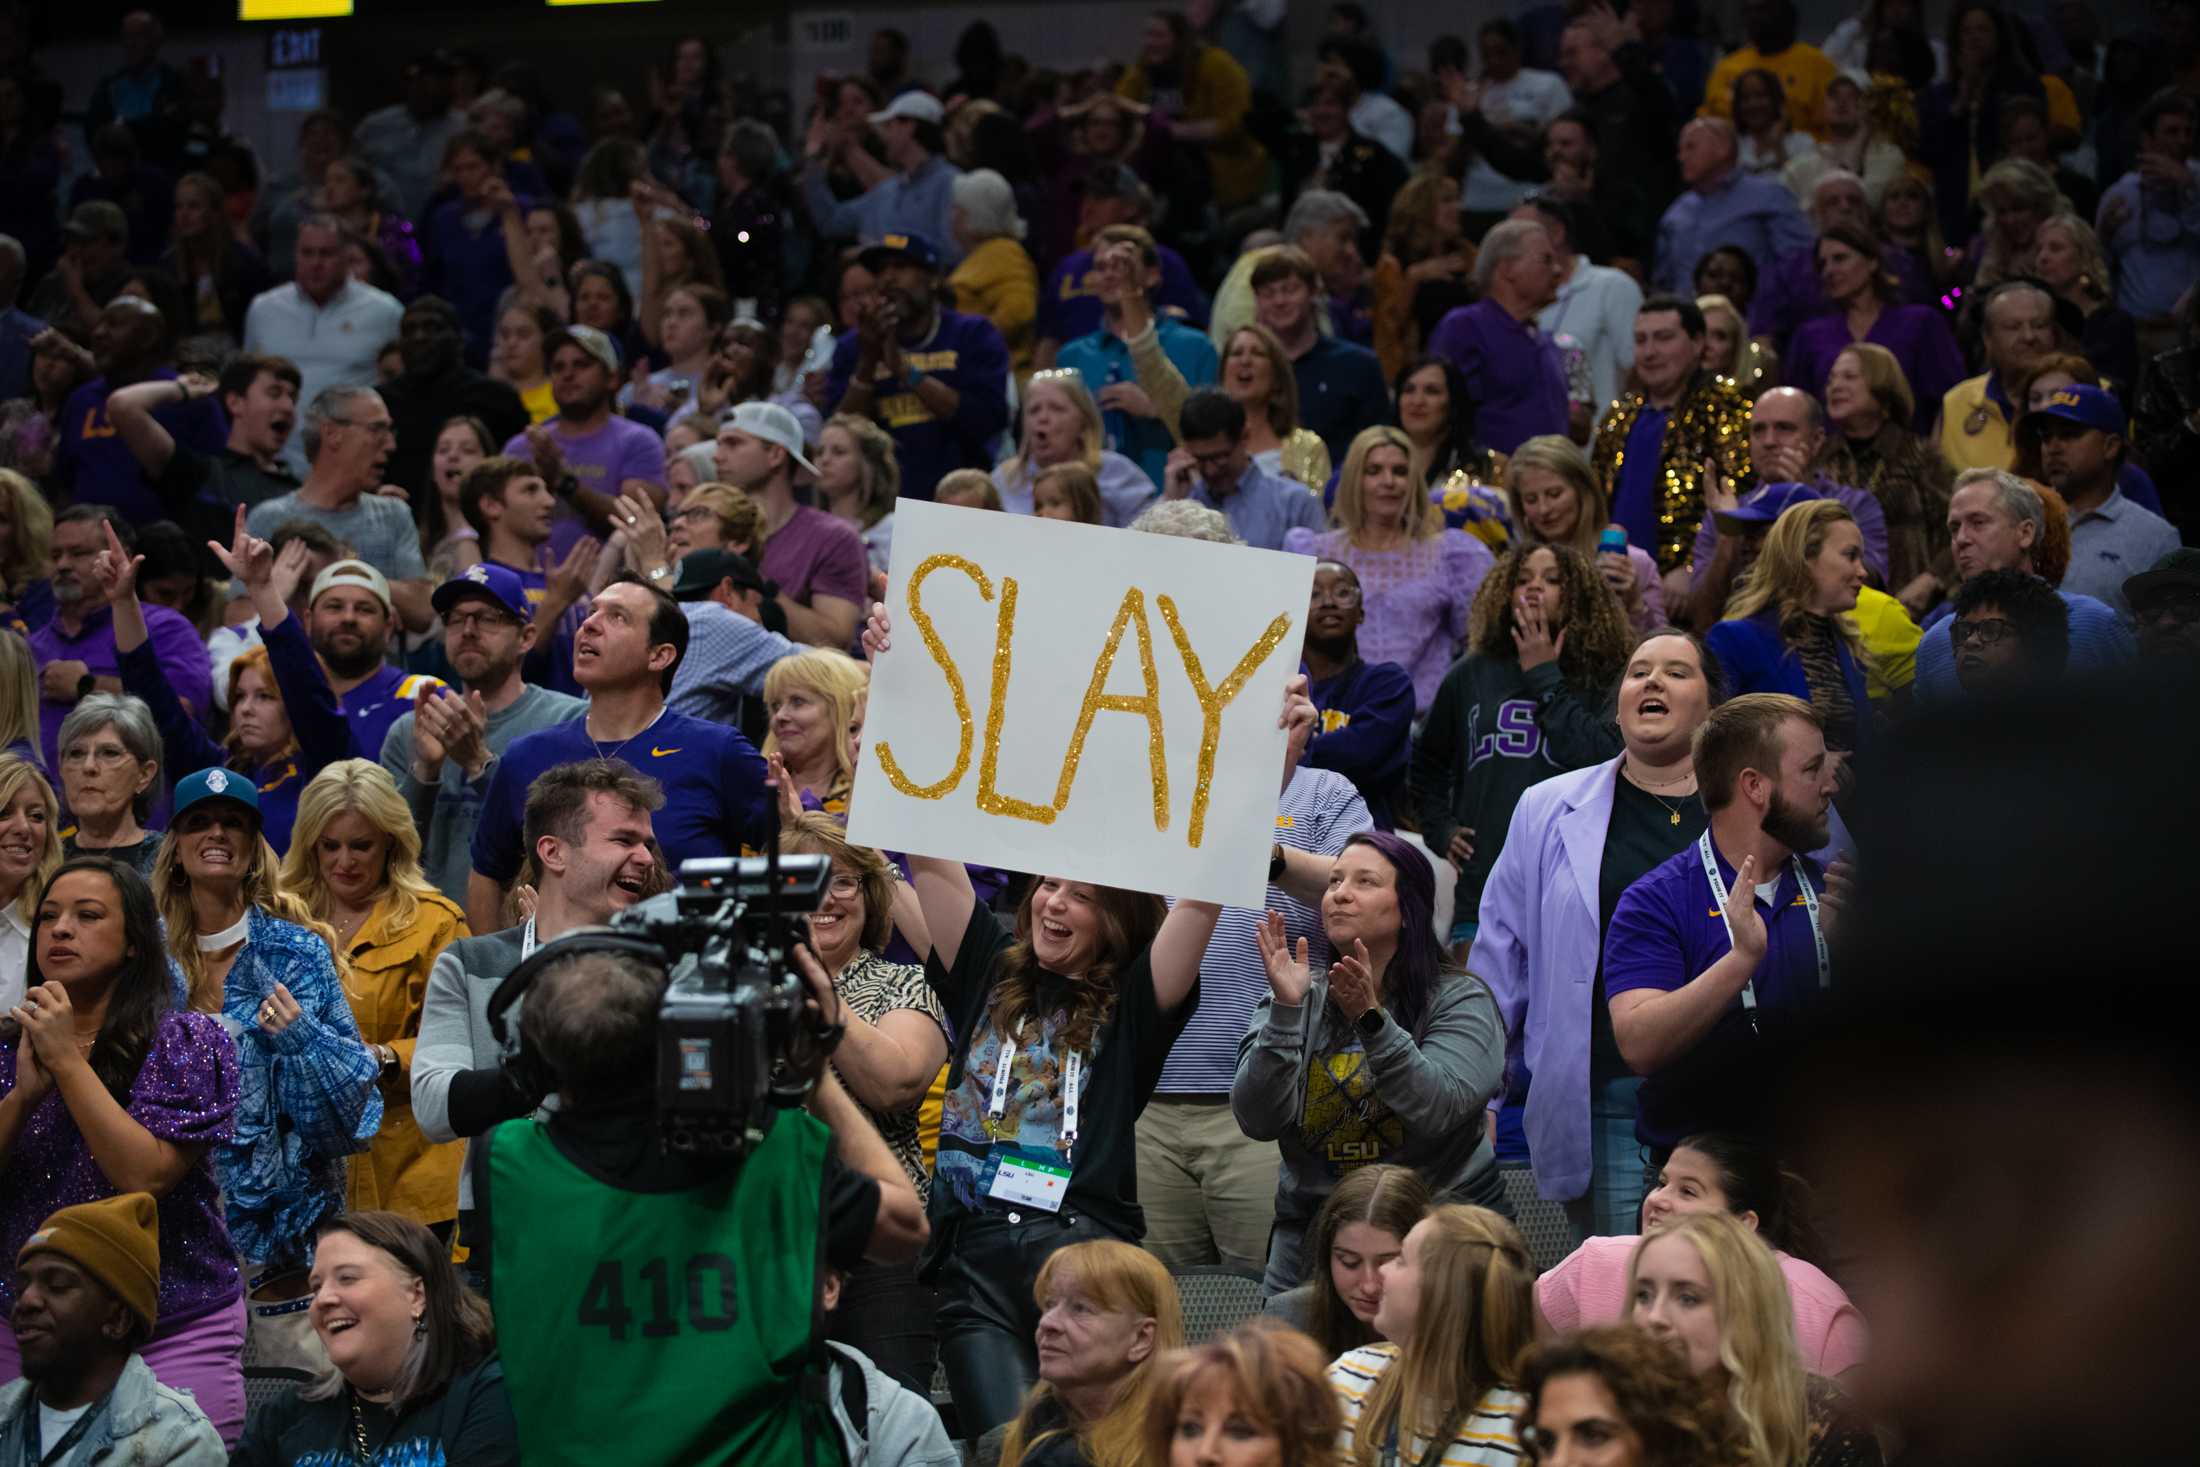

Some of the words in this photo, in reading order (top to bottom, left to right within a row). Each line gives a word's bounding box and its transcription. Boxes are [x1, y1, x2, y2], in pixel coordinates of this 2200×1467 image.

[875, 553, 1292, 849] SLAY
[1467, 698, 1566, 771] LS
[1327, 1140, 1380, 1161] LSU
[579, 1253, 738, 1340] 410
